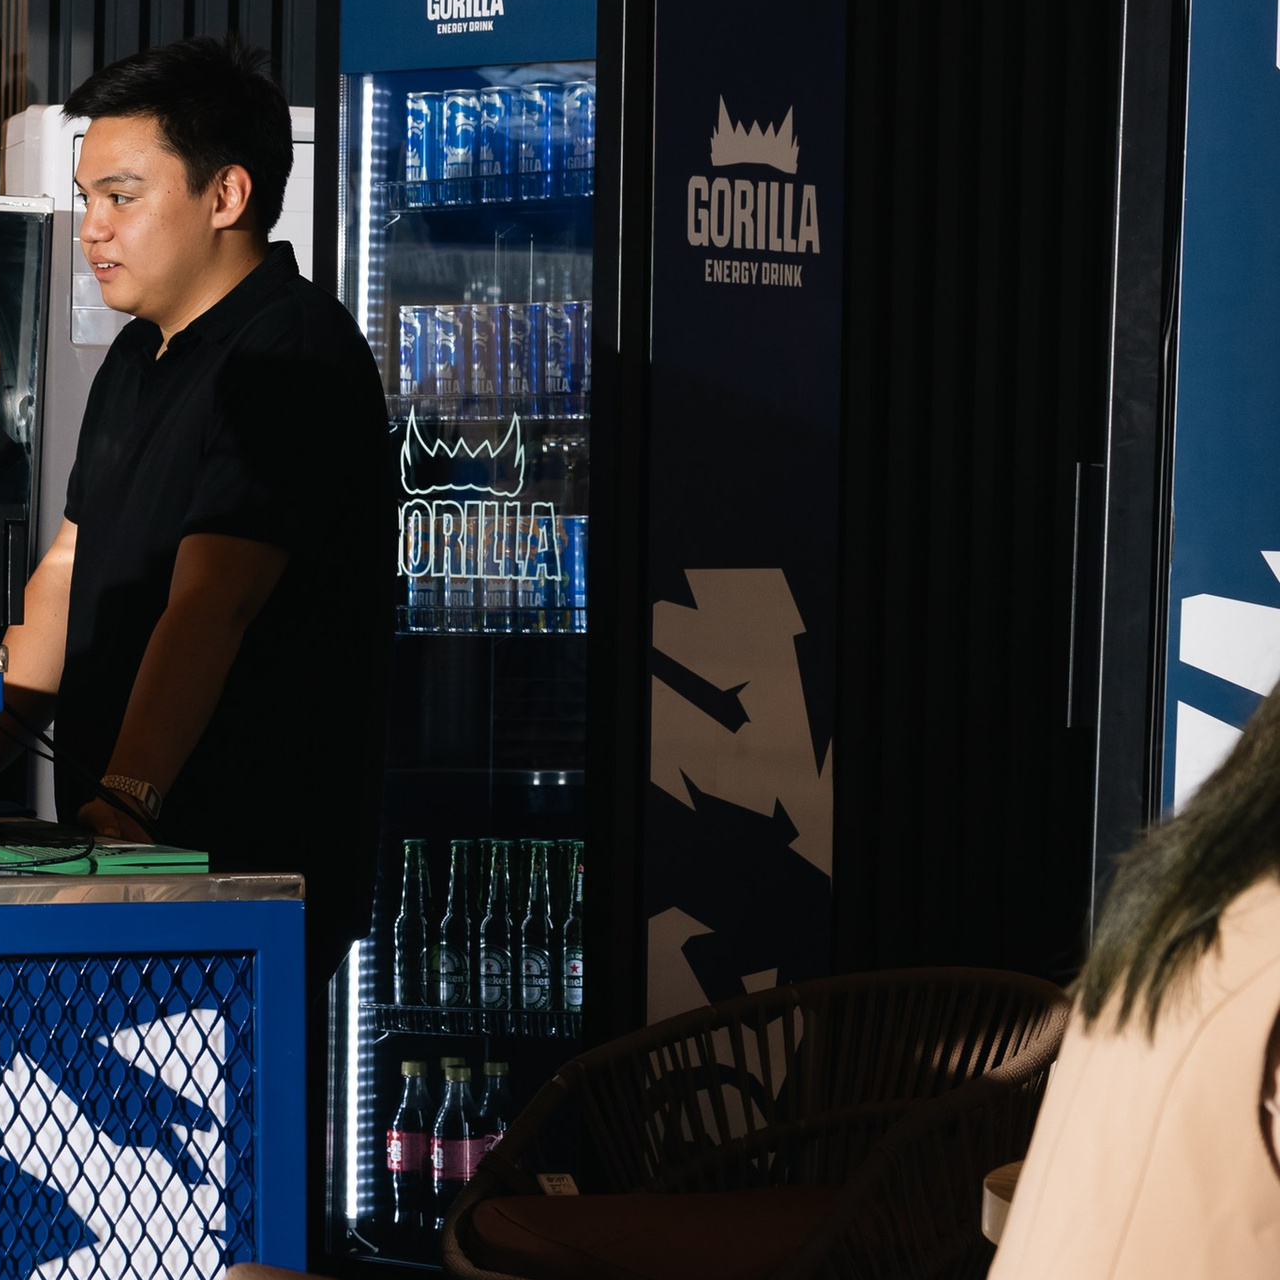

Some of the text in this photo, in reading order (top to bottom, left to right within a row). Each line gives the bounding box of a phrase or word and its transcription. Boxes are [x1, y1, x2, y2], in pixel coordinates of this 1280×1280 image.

[437, 20, 494, 35] ENERGY DRINK
[687, 175, 820, 254] GORILLA
[705, 259, 803, 287] ENERGY DRINK
[397, 499, 562, 581] ORILLA
